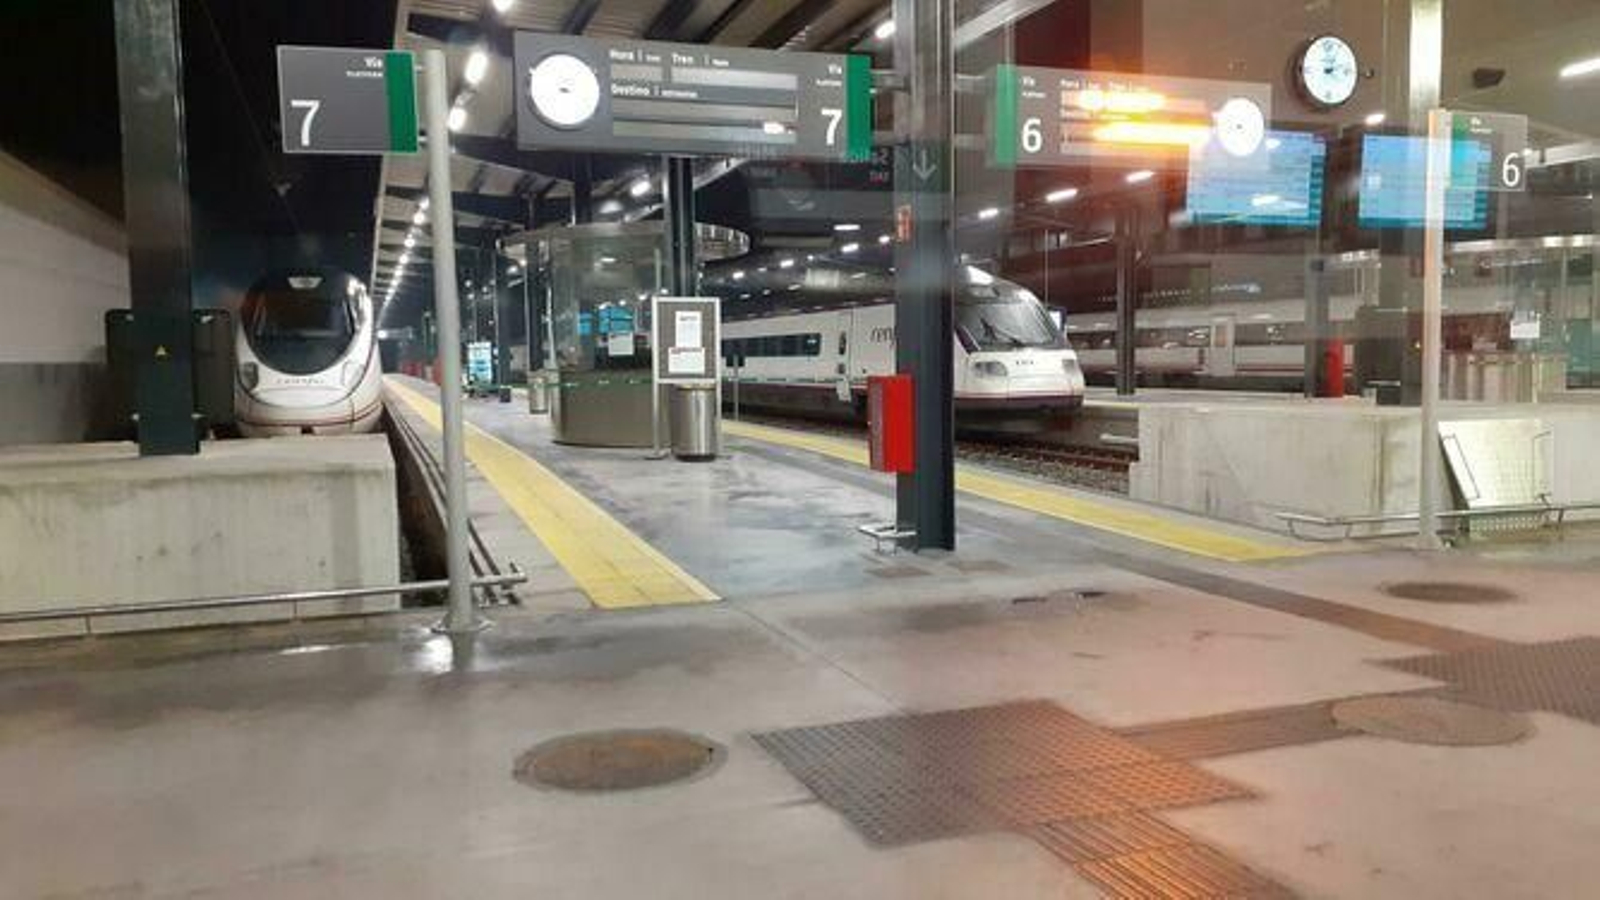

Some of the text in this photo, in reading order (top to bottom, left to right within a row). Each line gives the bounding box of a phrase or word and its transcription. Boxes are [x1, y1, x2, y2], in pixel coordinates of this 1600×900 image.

[290, 99, 320, 147] 7
[820, 108, 843, 146] 7
[1021, 117, 1043, 154] 6
[1502, 152, 1521, 188] 6
